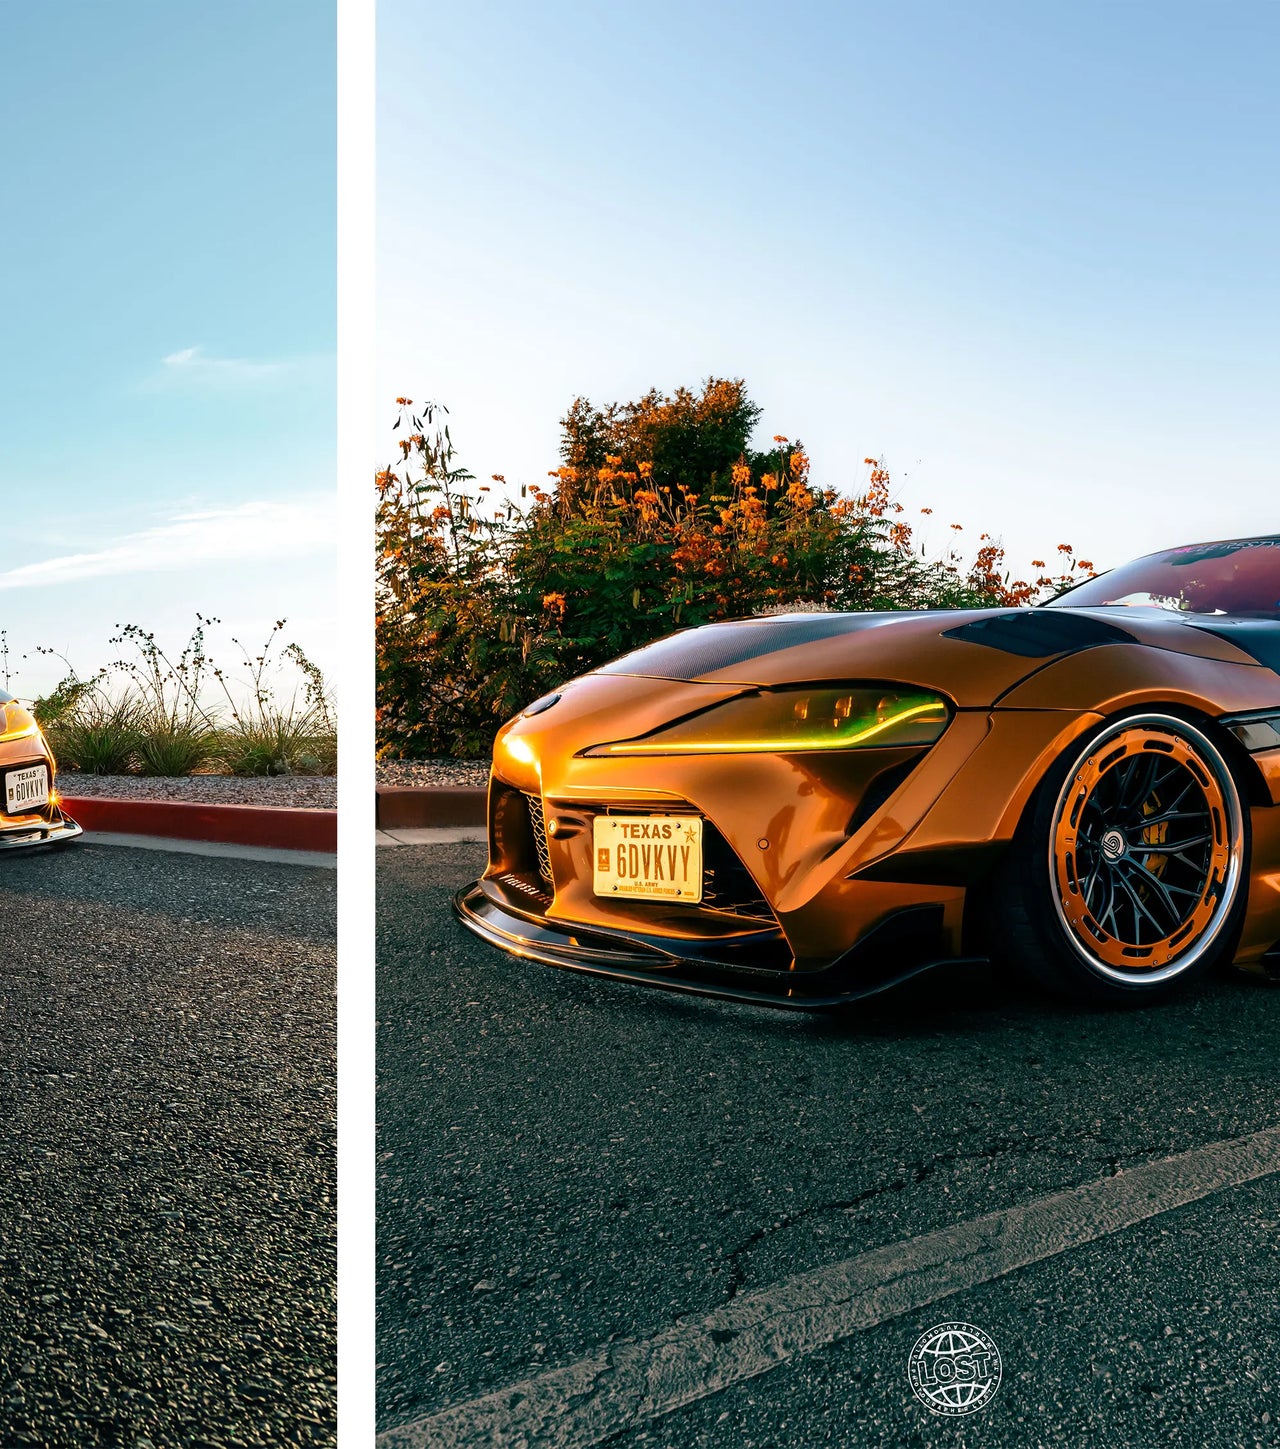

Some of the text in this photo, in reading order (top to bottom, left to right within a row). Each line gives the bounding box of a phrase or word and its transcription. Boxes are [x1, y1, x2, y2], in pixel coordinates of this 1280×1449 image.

[18, 771, 37, 781] TEXAS
[16, 778, 44, 801] 6DVKVY
[621, 824, 672, 839] TEXAS
[617, 843, 690, 882] 6DVKVY
